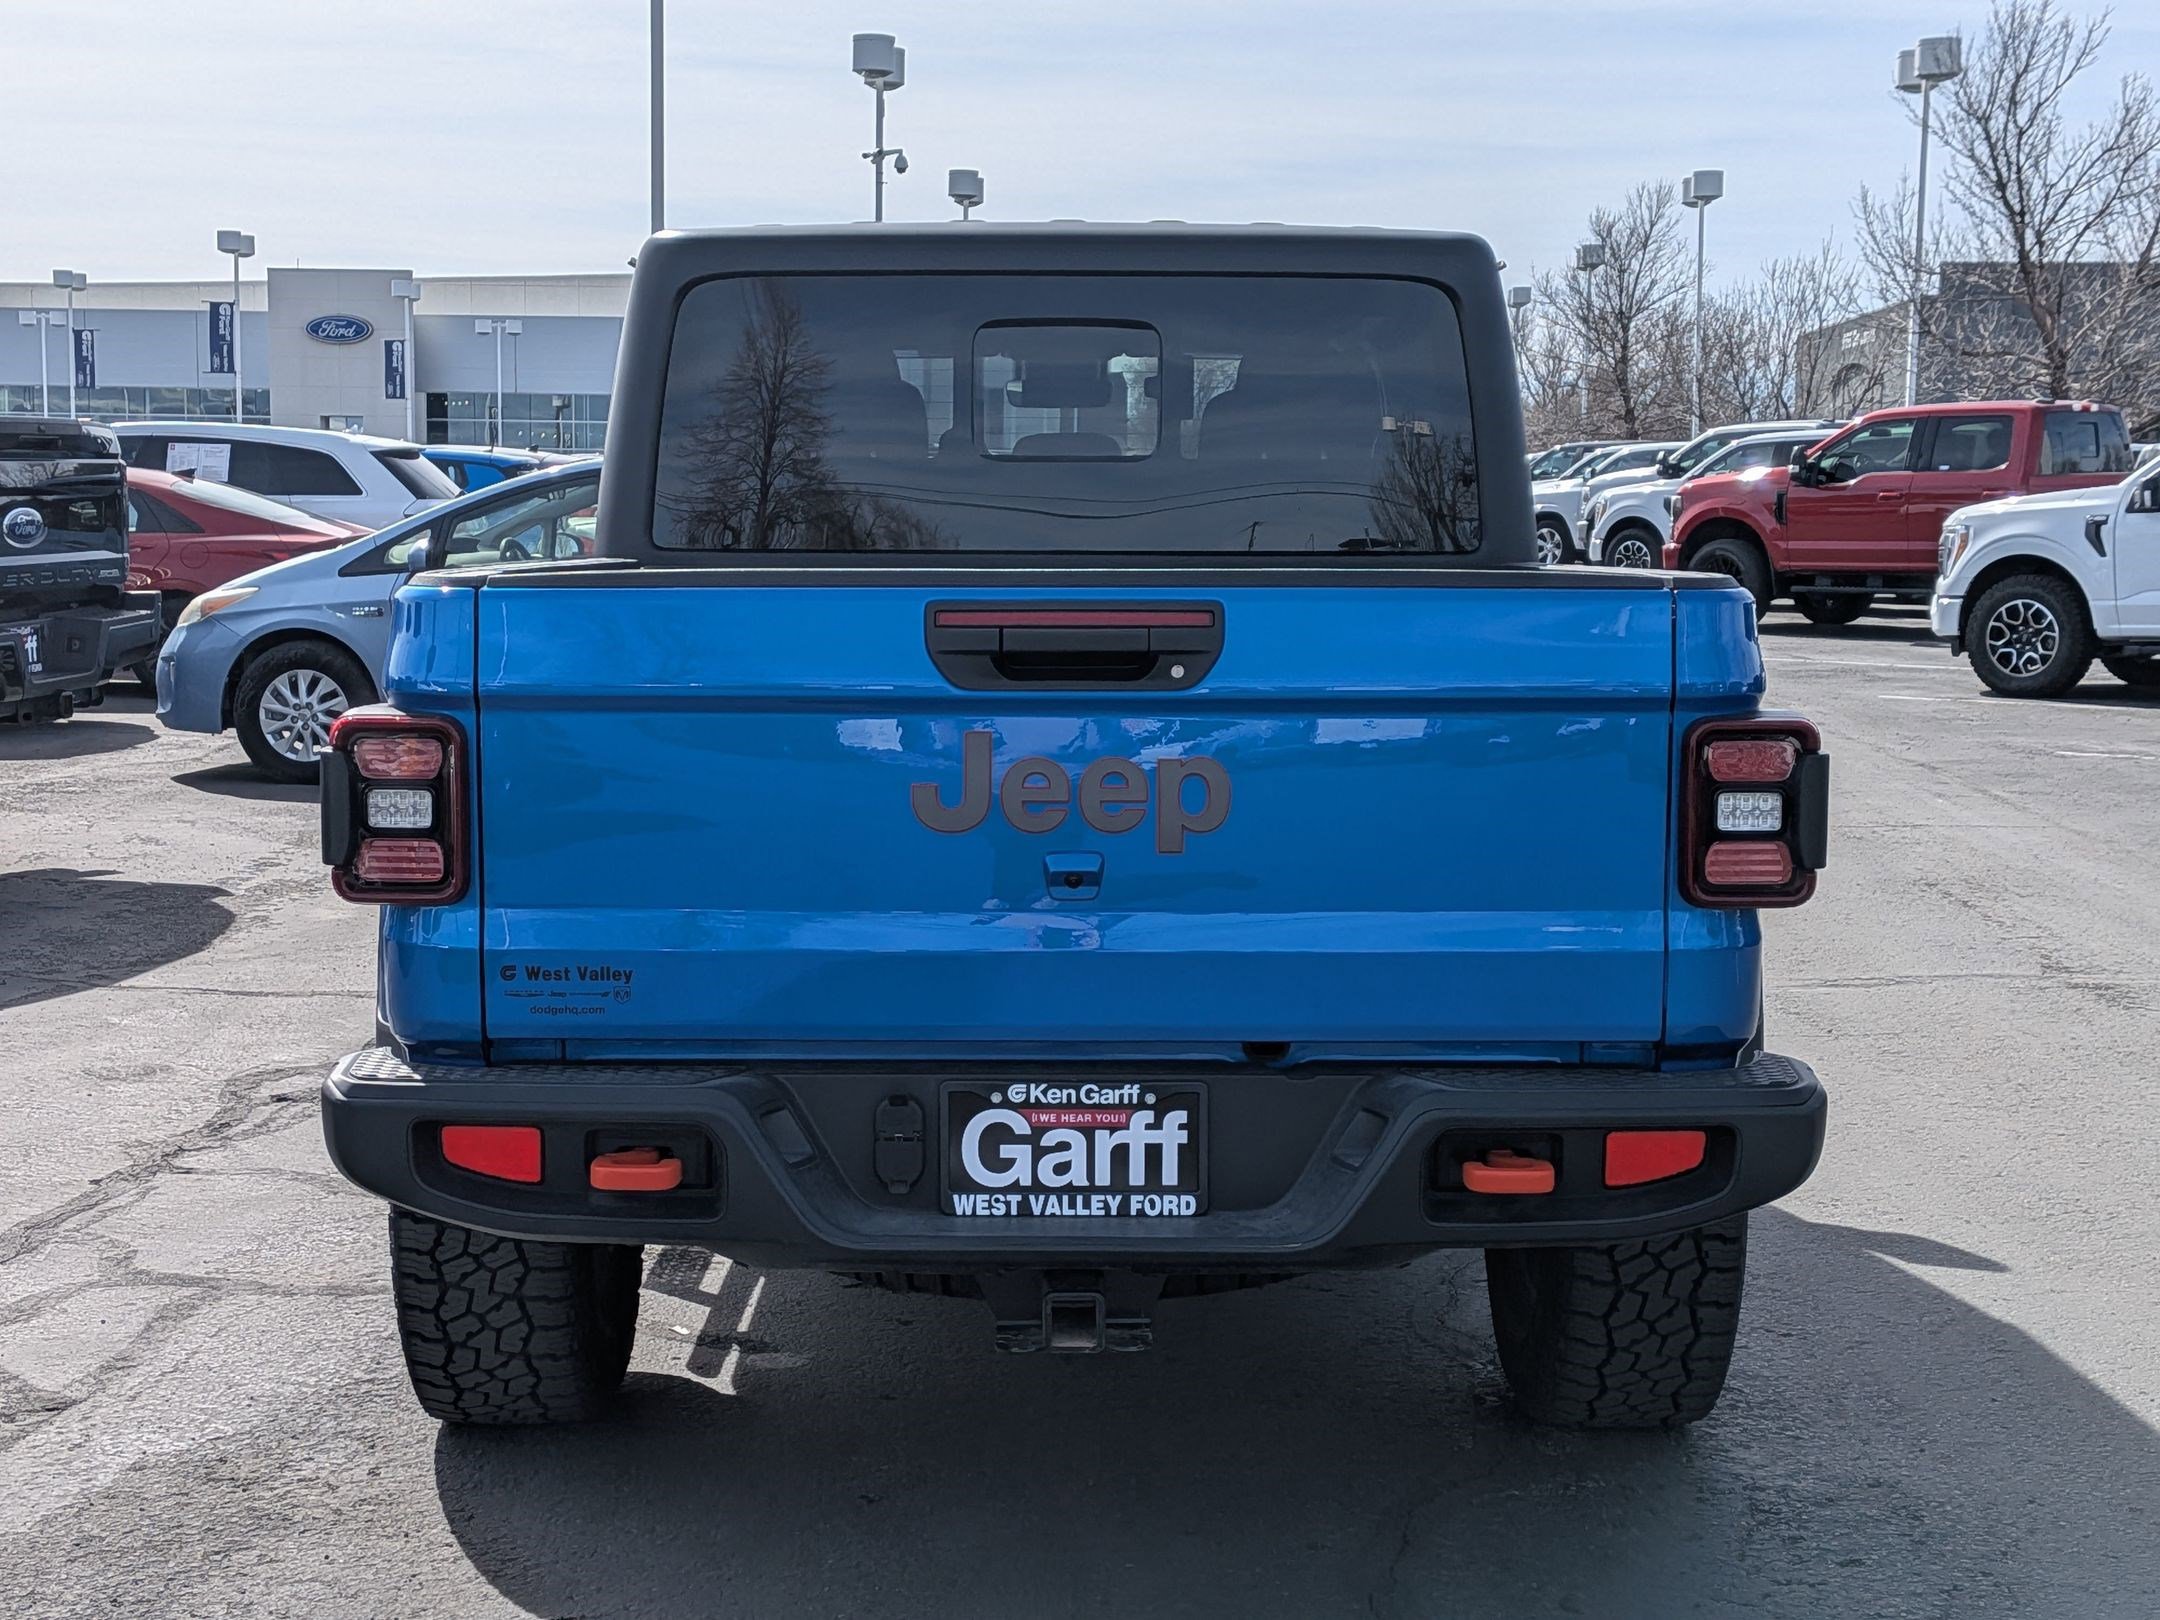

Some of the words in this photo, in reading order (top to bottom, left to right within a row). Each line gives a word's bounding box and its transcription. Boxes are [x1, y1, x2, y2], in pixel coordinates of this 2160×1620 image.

[318, 320, 357, 337] Ford
[911, 731, 1231, 854] Jeep
[525, 965, 570, 981] West
[576, 965, 634, 984] Valley
[530, 1005, 606, 1016] dodgehq.com
[1030, 1084, 1076, 1104] Ken
[1080, 1084, 1141, 1104] Garff
[1040, 1113, 1058, 1123] WE
[1061, 1113, 1093, 1123] HEAR
[1095, 1113, 1119, 1123] YOU
[961, 1109, 1189, 1187] Garff
[953, 1194, 1022, 1216] WEST
[1029, 1194, 1121, 1216] VALLEY
[1130, 1194, 1197, 1216] FORD
